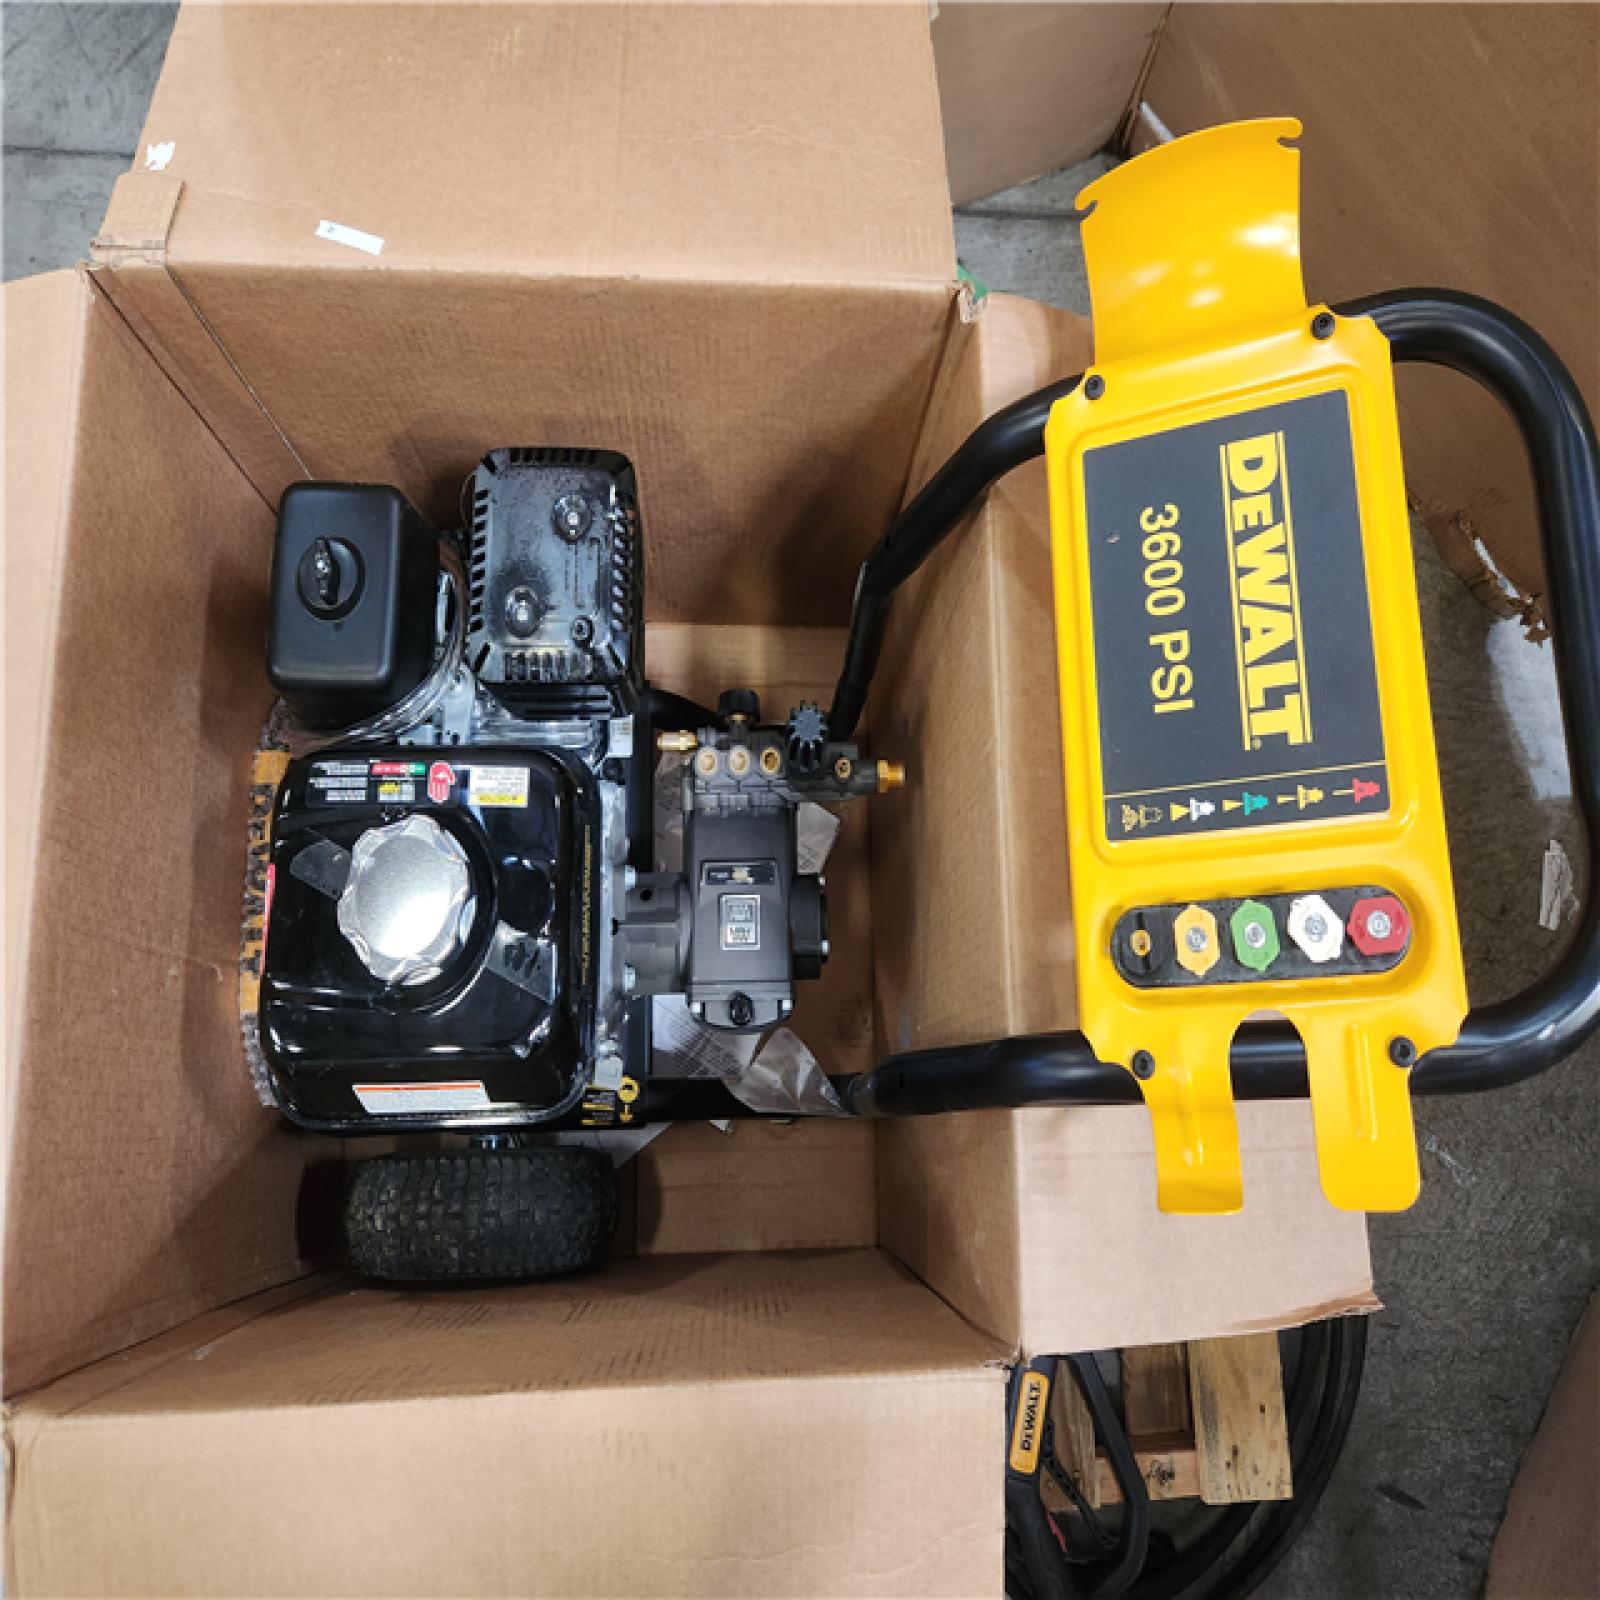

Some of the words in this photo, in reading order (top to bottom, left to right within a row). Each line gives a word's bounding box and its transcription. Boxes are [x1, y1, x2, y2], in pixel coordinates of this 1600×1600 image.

[1139, 502, 1186, 616] 3600
[1225, 431, 1305, 746] DEWALT
[1149, 629, 1195, 714] PSI
